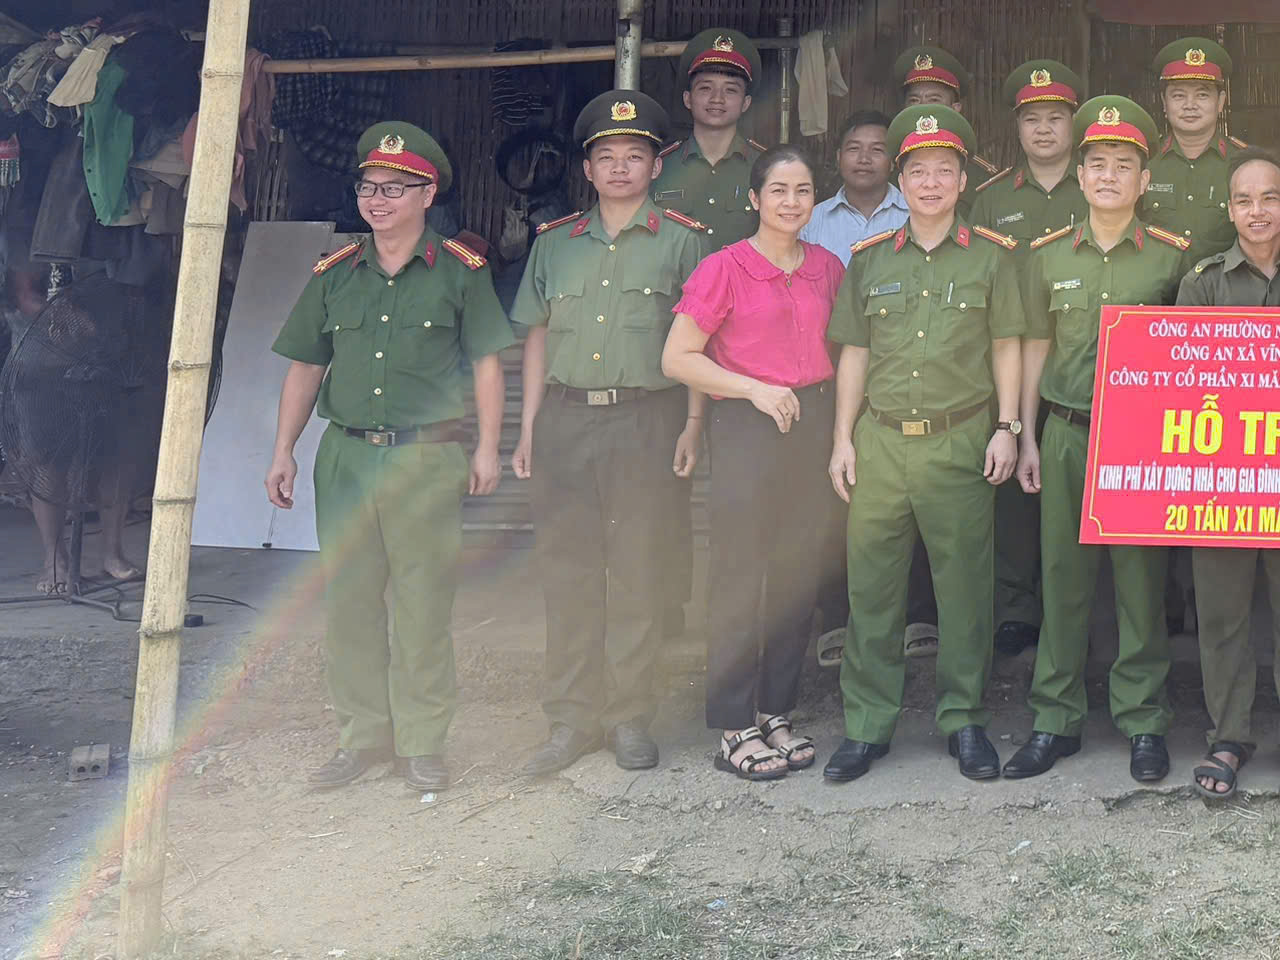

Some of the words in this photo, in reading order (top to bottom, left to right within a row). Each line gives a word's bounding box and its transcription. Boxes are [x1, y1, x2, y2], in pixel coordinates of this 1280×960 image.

[1149, 319, 1187, 337] CÔNG
[1192, 324, 1211, 337] AN
[1214, 320, 1271, 339] PHƯỜNG
[1171, 343, 1209, 360] CÔNG
[1213, 348, 1233, 360] AN
[1237, 343, 1256, 362] XÃ
[1110, 366, 1149, 386] CÔNG
[1152, 372, 1172, 386] TY
[1175, 365, 1195, 386] CỔ
[1198, 365, 1237, 388] PHẦN
[1240, 373, 1254, 388] XI
[1161, 394, 1223, 455] HỖ
[1099, 465, 1122, 490] KINH
[1124, 461, 1142, 490] PHÍ
[1142, 461, 1162, 491] XÂY
[1194, 462, 1214, 492] NHÀ
[1217, 468, 1235, 492] CHO
[1239, 469, 1255, 493] GIA
[1257, 464, 1280, 494] ĐÌNH
[1165, 505, 1188, 531] 20
[1194, 497, 1229, 532] TẤN
[1235, 506, 1252, 532] XI
